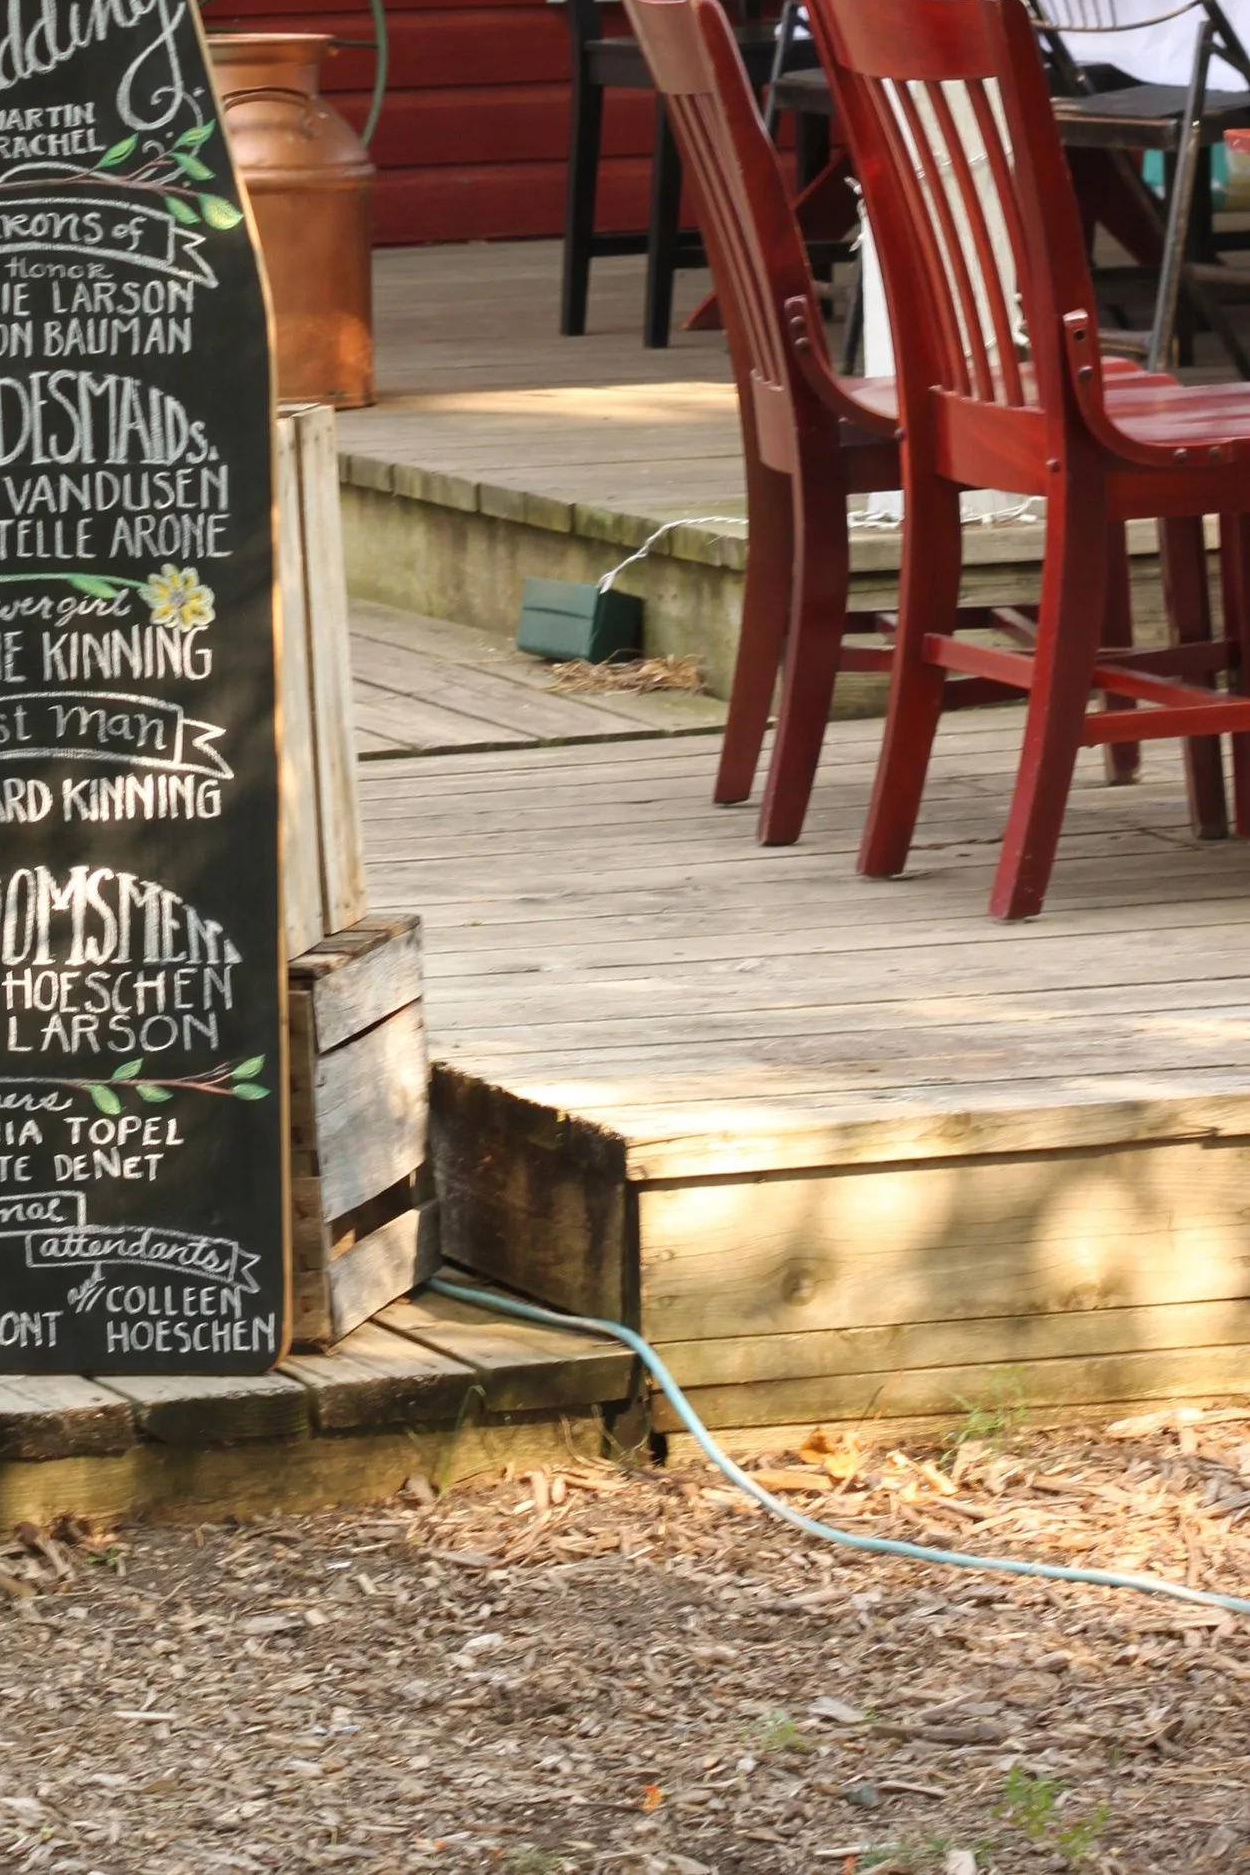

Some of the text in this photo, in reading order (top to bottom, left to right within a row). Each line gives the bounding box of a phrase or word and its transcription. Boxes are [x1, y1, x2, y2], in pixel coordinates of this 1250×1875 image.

[112, 215, 144, 249] of
[52, 279, 195, 317] LARSON
[43, 317, 192, 357] BAUMAN
[4, 464, 230, 512] VANDUSEN
[110, 513, 234, 560] ARONE
[54, 588, 132, 626] girl
[43, 624, 213, 681] KINNING
[63, 774, 222, 822] KINNING
[1, 967, 233, 1015] HOESCHEN
[7, 1013, 219, 1054] LARSON
[64, 1116, 185, 1145] TOPEL
[39, 1227, 232, 1271] attendants
[106, 1285, 243, 1317] COLLEEN
[108, 1313, 276, 1354] HOESCHEN
